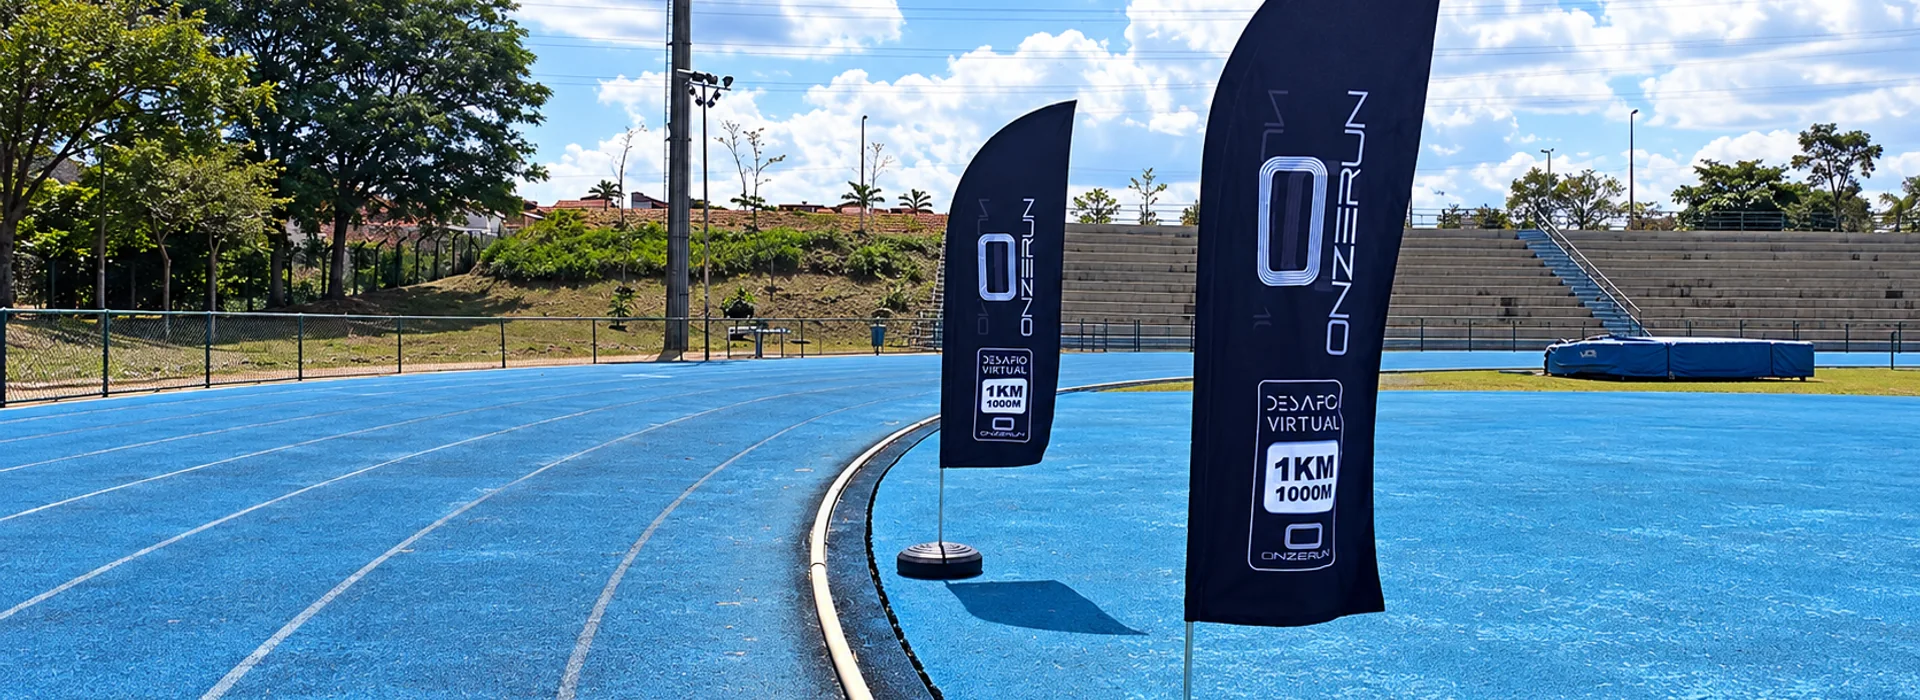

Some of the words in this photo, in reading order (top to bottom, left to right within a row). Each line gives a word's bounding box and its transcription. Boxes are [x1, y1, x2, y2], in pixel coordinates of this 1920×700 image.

[1326, 90, 1368, 356] ONZERUN
[1020, 198, 1035, 337] ONZERUN
[982, 355, 1027, 365] DESAFIO
[982, 366, 1027, 375] VIRTUAL
[986, 385, 1023, 398] 1KM
[986, 400, 1021, 408] 1000M
[1267, 416, 1340, 432] VIRTUAL
[1274, 455, 1335, 482] 1KM
[1275, 484, 1332, 502] 1000M
[1261, 549, 1330, 561] ONZERUN
